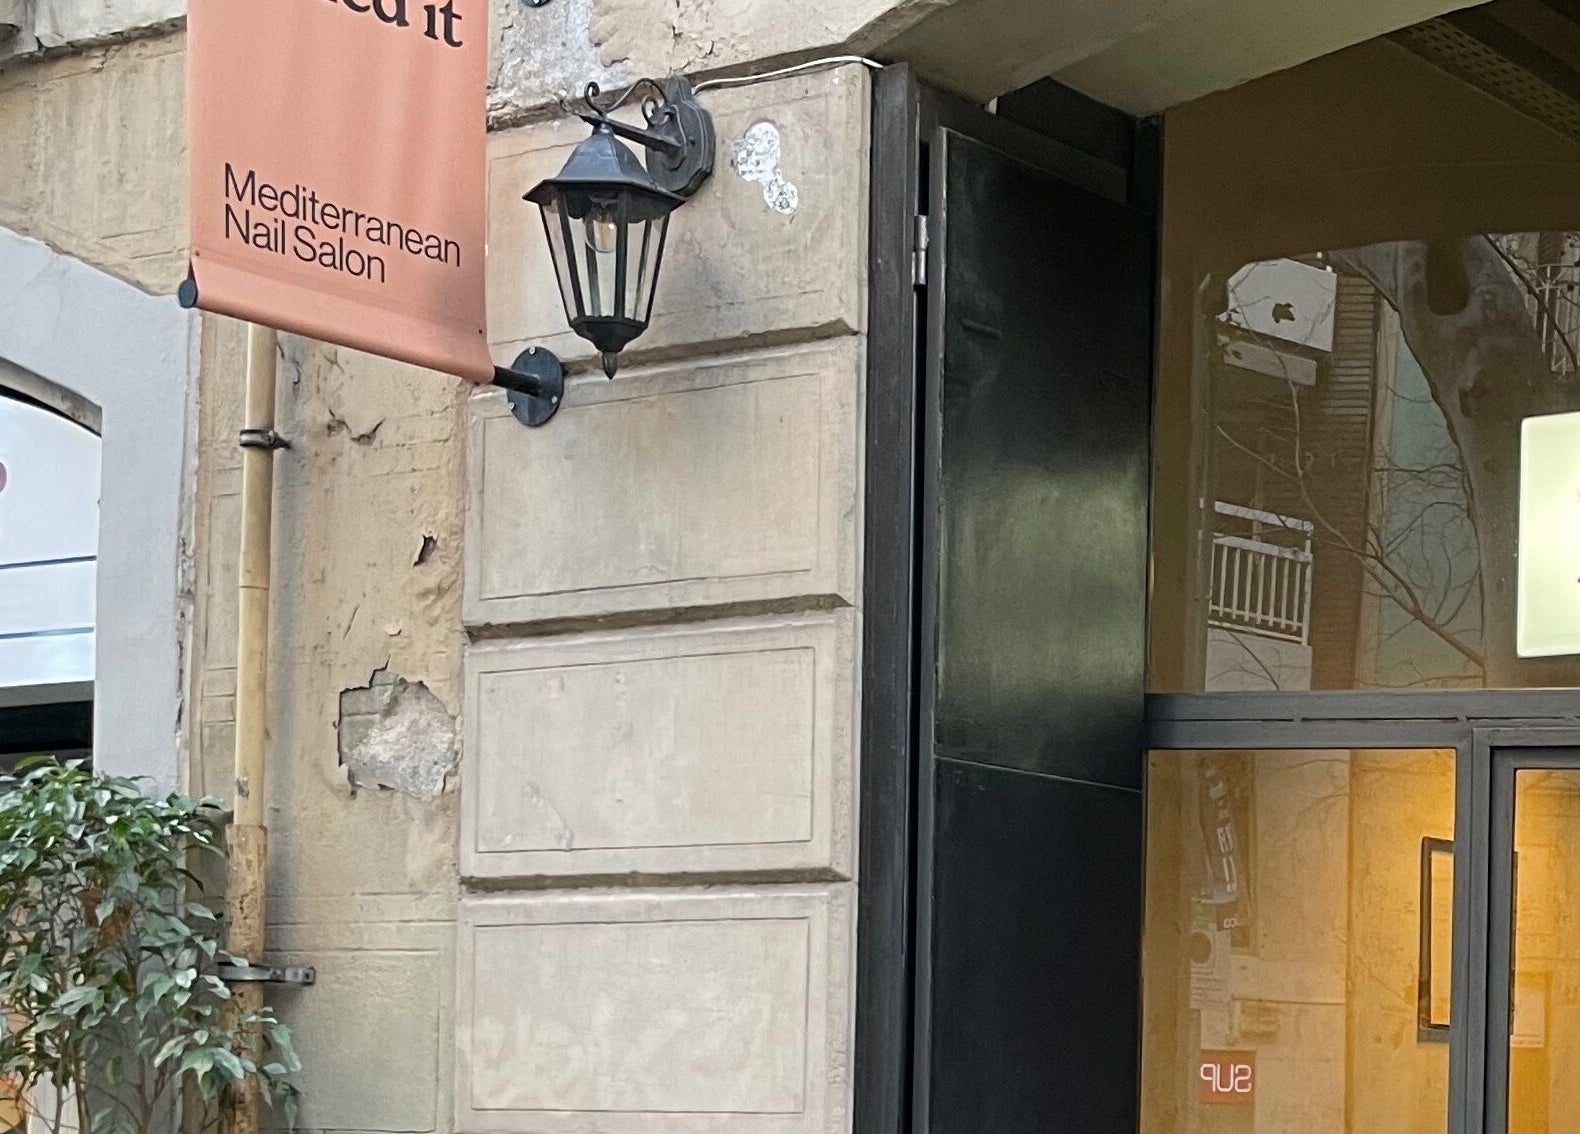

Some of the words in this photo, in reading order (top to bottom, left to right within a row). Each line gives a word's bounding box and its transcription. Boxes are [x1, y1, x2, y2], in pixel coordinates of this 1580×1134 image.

[224, 162, 461, 267] Mediterranean
[224, 203, 286, 255] Nail
[292, 225, 386, 284] Salon
